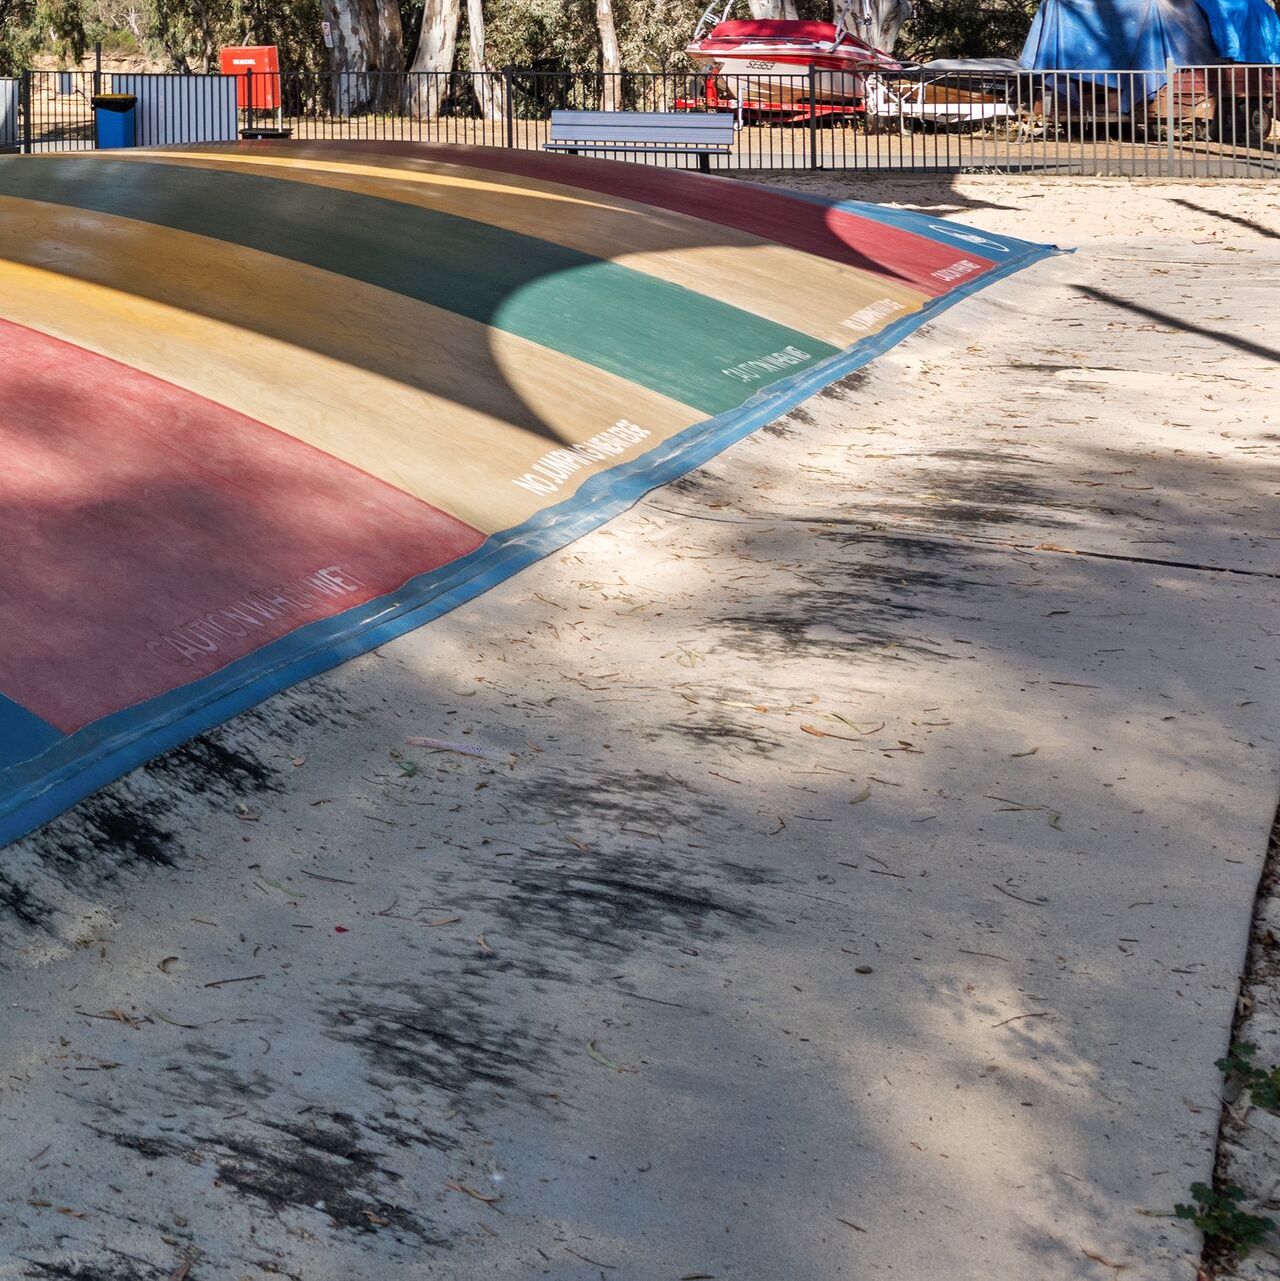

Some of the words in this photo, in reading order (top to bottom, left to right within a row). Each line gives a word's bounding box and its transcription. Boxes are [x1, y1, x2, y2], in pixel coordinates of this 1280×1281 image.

[584, 431, 625, 457] NEAR
[607, 419, 651, 447] EDGE
[531, 444, 606, 485] JUMPING
[512, 473, 559, 497] NO
[144, 604, 266, 664] CAUTION
[238, 579, 326, 620] WHEN
[306, 566, 367, 599] WET
